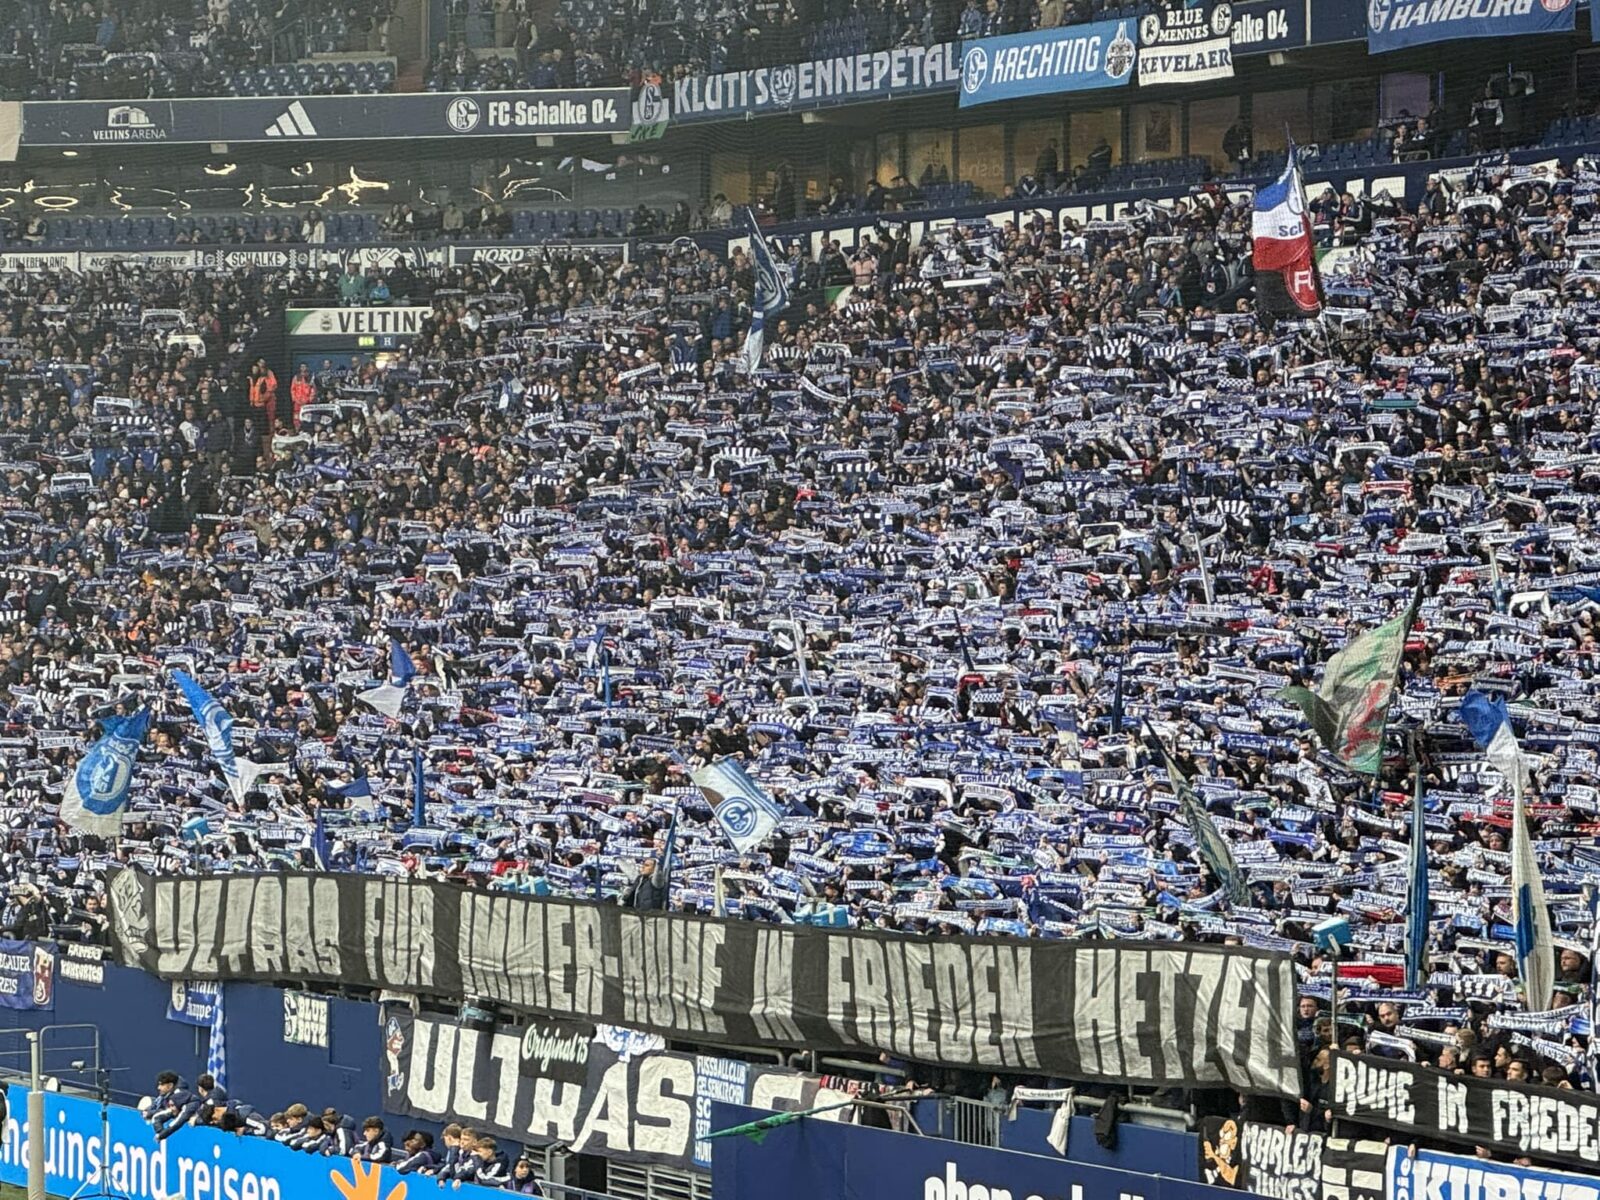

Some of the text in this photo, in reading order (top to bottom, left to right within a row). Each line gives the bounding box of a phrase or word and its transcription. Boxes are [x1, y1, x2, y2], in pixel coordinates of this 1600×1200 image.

[1166, 8, 1203, 25] BLUE
[1267, 9, 1288, 40] 04
[1390, 0, 1533, 31] HAMBURG
[1158, 23, 1209, 42] MENNES
[799, 43, 960, 99] ENNEPETAL
[991, 36, 1101, 84] KRECHTING
[1140, 49, 1231, 75] KEVELAER
[488, 98, 617, 126] FC Schalke 04
[93, 129, 166, 140] VELTINS ARENA
[232, 252, 281, 267] SCHALKE
[473, 248, 525, 264] NORD
[338, 310, 431, 333] VELTINS
[155, 876, 342, 975] ULTRAS
[750, 929, 806, 1041] IN
[827, 935, 1042, 1069] FRIEDEN
[522, 1024, 577, 1072] Original
[576, 1035, 589, 1064] 75
[1335, 1056, 1415, 1125] RUHE
[1438, 1076, 1468, 1134] IN
[1241, 1122, 1323, 1180] MARLER
[178, 1144, 281, 1200] reisen
